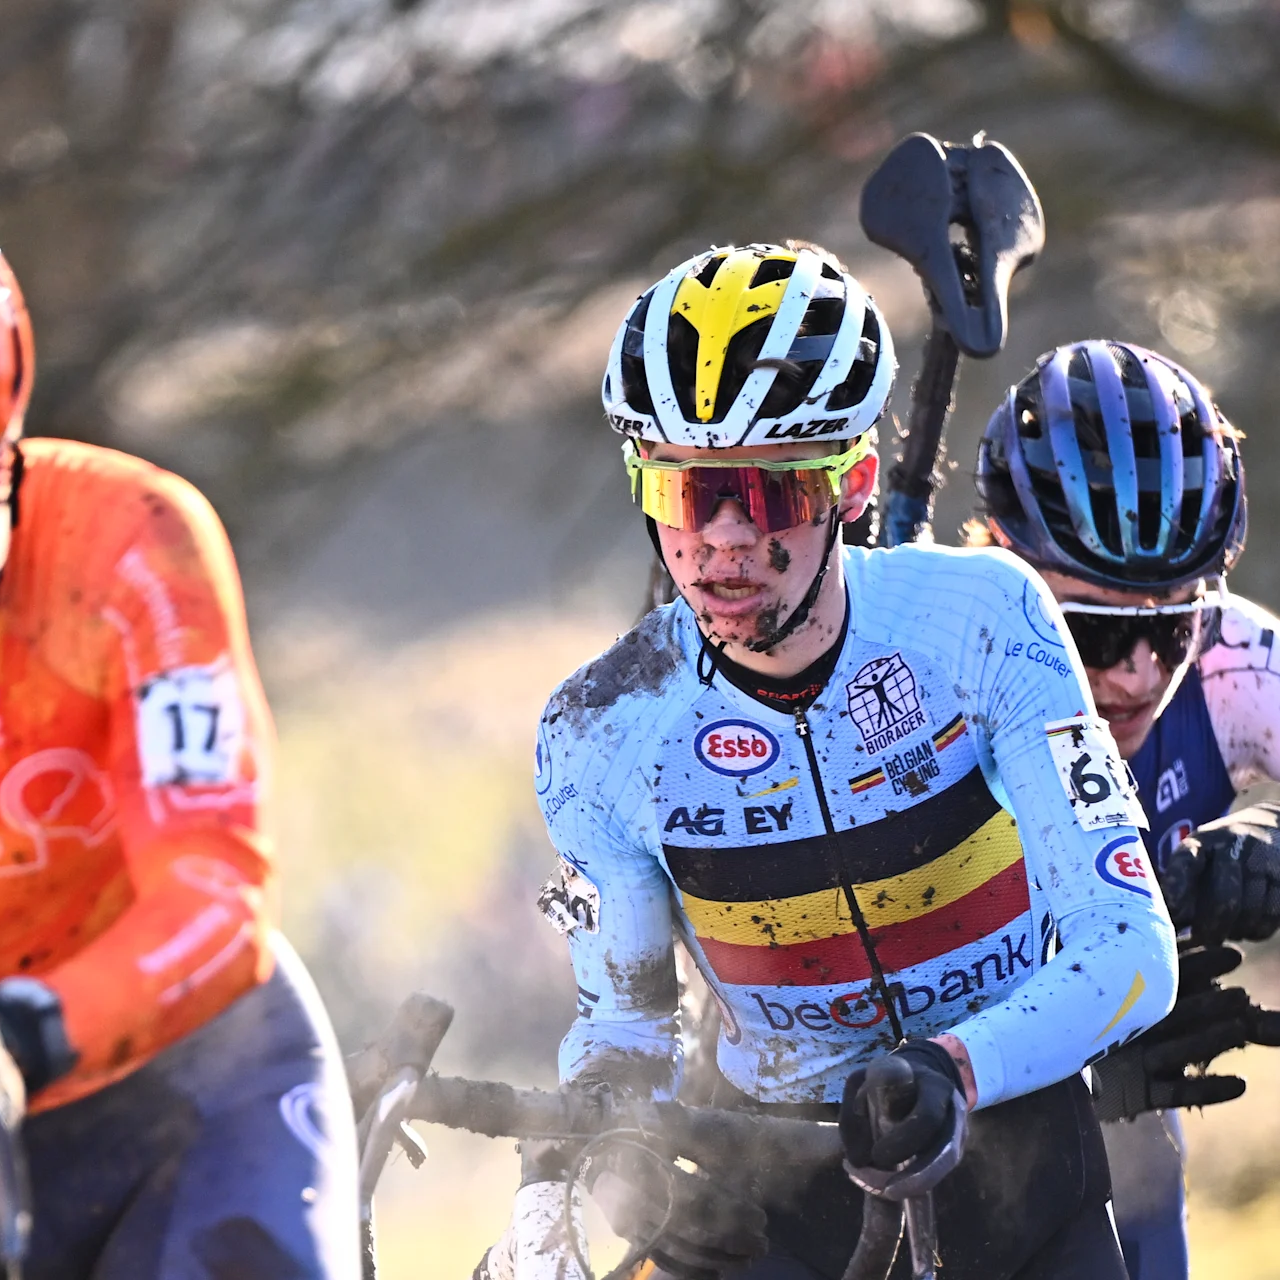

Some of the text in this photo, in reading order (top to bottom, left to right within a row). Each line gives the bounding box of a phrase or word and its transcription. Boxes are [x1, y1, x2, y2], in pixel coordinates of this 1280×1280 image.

[764, 417, 849, 439] LAZER
[1005, 637, 1072, 679] Le Couter
[165, 702, 220, 752] 17
[708, 734, 768, 758] Esso
[865, 710, 926, 755] BIORACER
[885, 739, 934, 779] BELGIAN
[891, 757, 940, 796] CYING
[546, 782, 579, 815] Couter
[743, 803, 793, 835] EY
[751, 931, 1034, 1030] beobank
